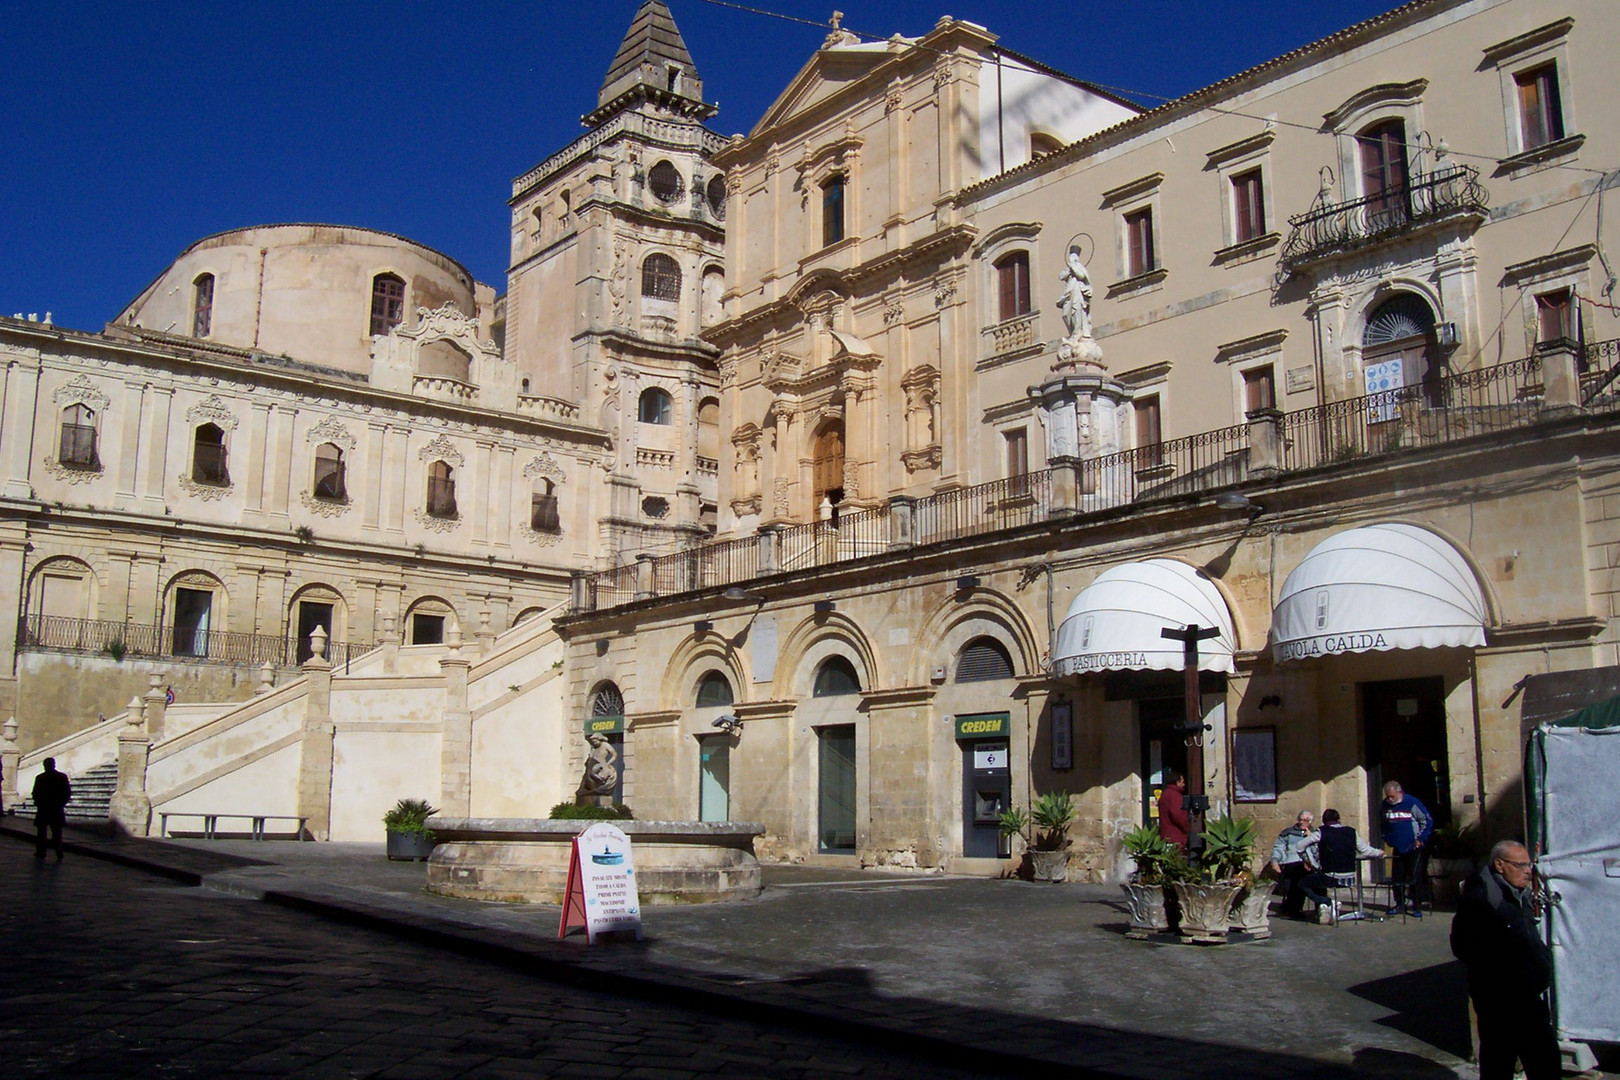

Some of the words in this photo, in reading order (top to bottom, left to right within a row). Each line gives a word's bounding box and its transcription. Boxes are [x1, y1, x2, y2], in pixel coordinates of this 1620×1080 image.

[1280, 640, 1320, 659] TAVOLA
[1325, 633, 1388, 652] CALDA
[1072, 653, 1148, 671] PASTICCERIA
[592, 721, 616, 731] CREDEM
[961, 719, 1002, 734] CREDEM
